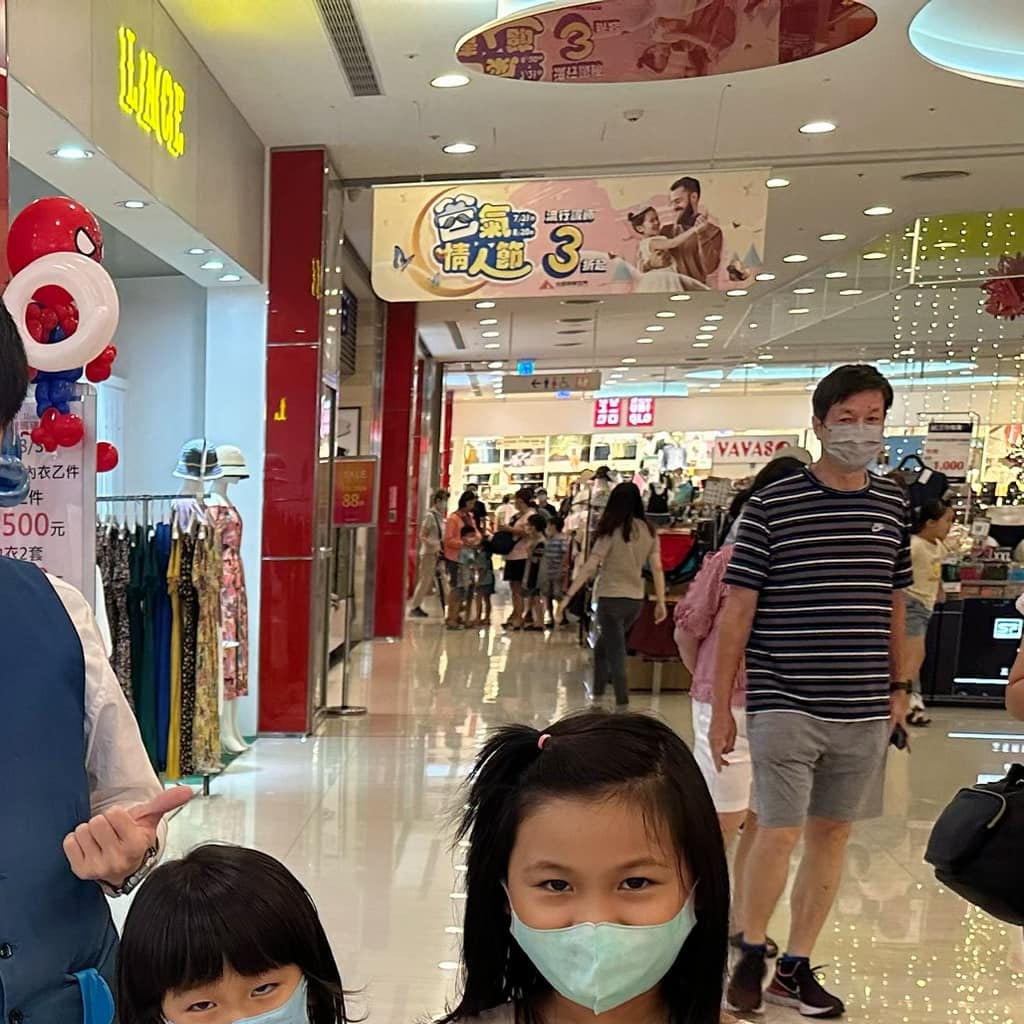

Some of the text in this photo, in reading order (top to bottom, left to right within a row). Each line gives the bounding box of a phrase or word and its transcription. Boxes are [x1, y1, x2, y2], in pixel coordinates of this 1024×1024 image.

[442, 241, 533, 279] 情人節
[544, 225, 584, 278] 3
